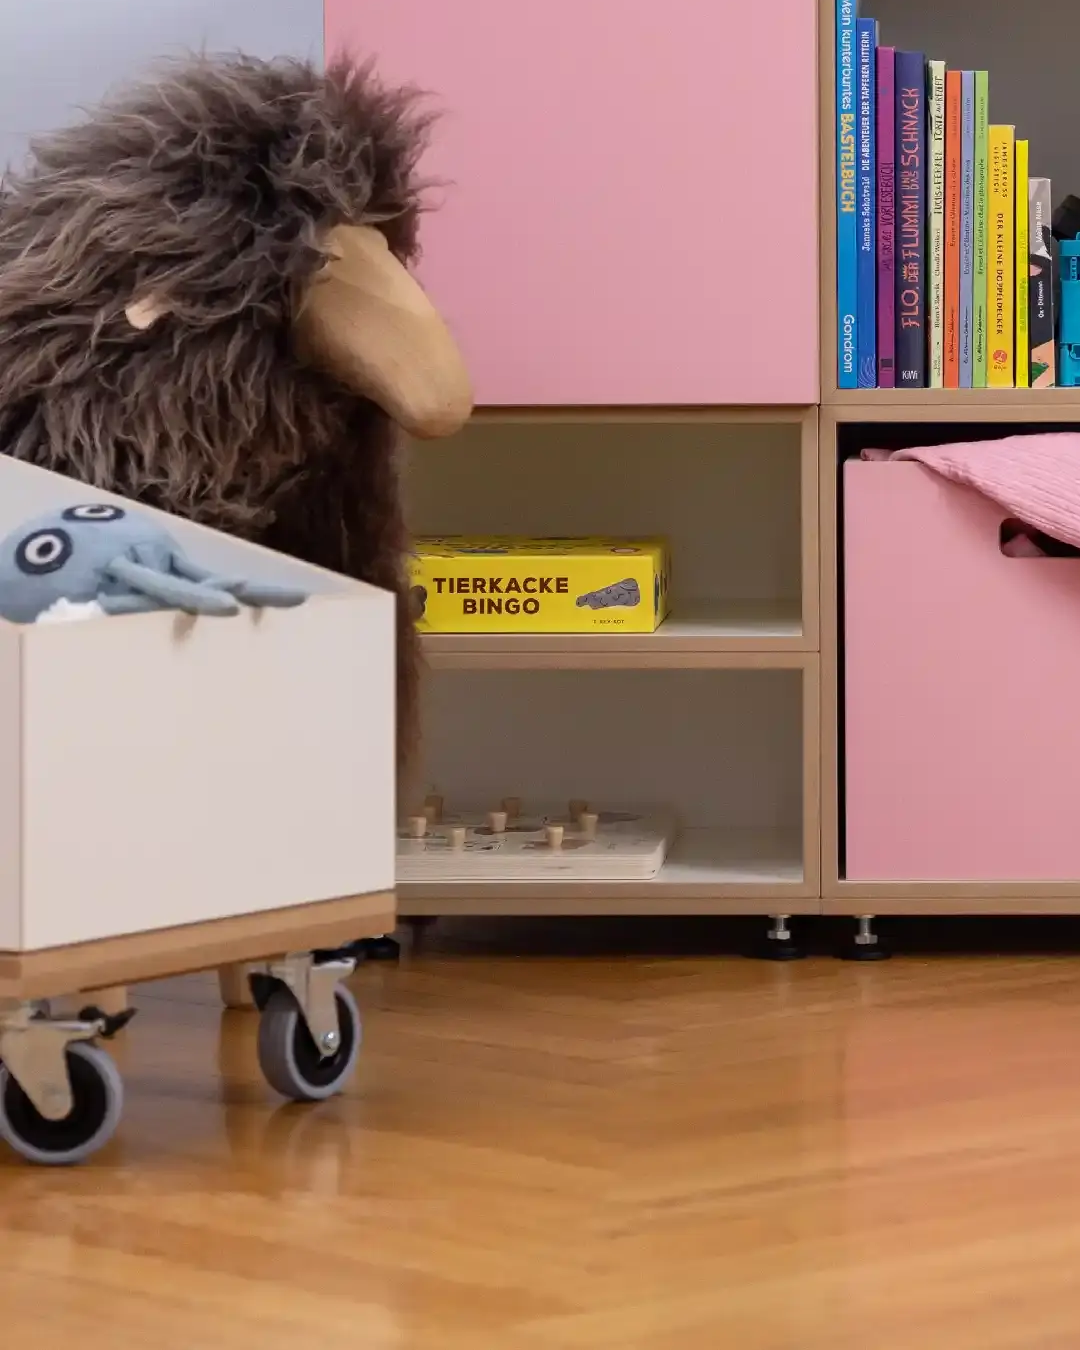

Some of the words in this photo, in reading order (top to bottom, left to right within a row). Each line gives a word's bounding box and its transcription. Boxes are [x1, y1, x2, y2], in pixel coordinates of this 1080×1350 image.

[862, 31, 870, 63] RITTERIN
[842, 29, 853, 110] kunterbuntes
[862, 64, 870, 99] TAPFEREN
[862, 101, 870, 115] DER
[862, 116, 870, 158] ABENTEUER
[902, 88, 919, 167] SCHNACK
[840, 113, 855, 212] BASTELBUCH
[862, 159, 870, 171] DIE
[910, 171, 918, 190] DAS
[901, 195, 920, 259] FLUMMI
[996, 213, 1004, 230] DER
[908, 262, 919, 282] DER
[843, 314, 855, 373] Gondrom
[432, 577, 569, 594] TIERKACKE
[462, 597, 540, 615] BINGO
